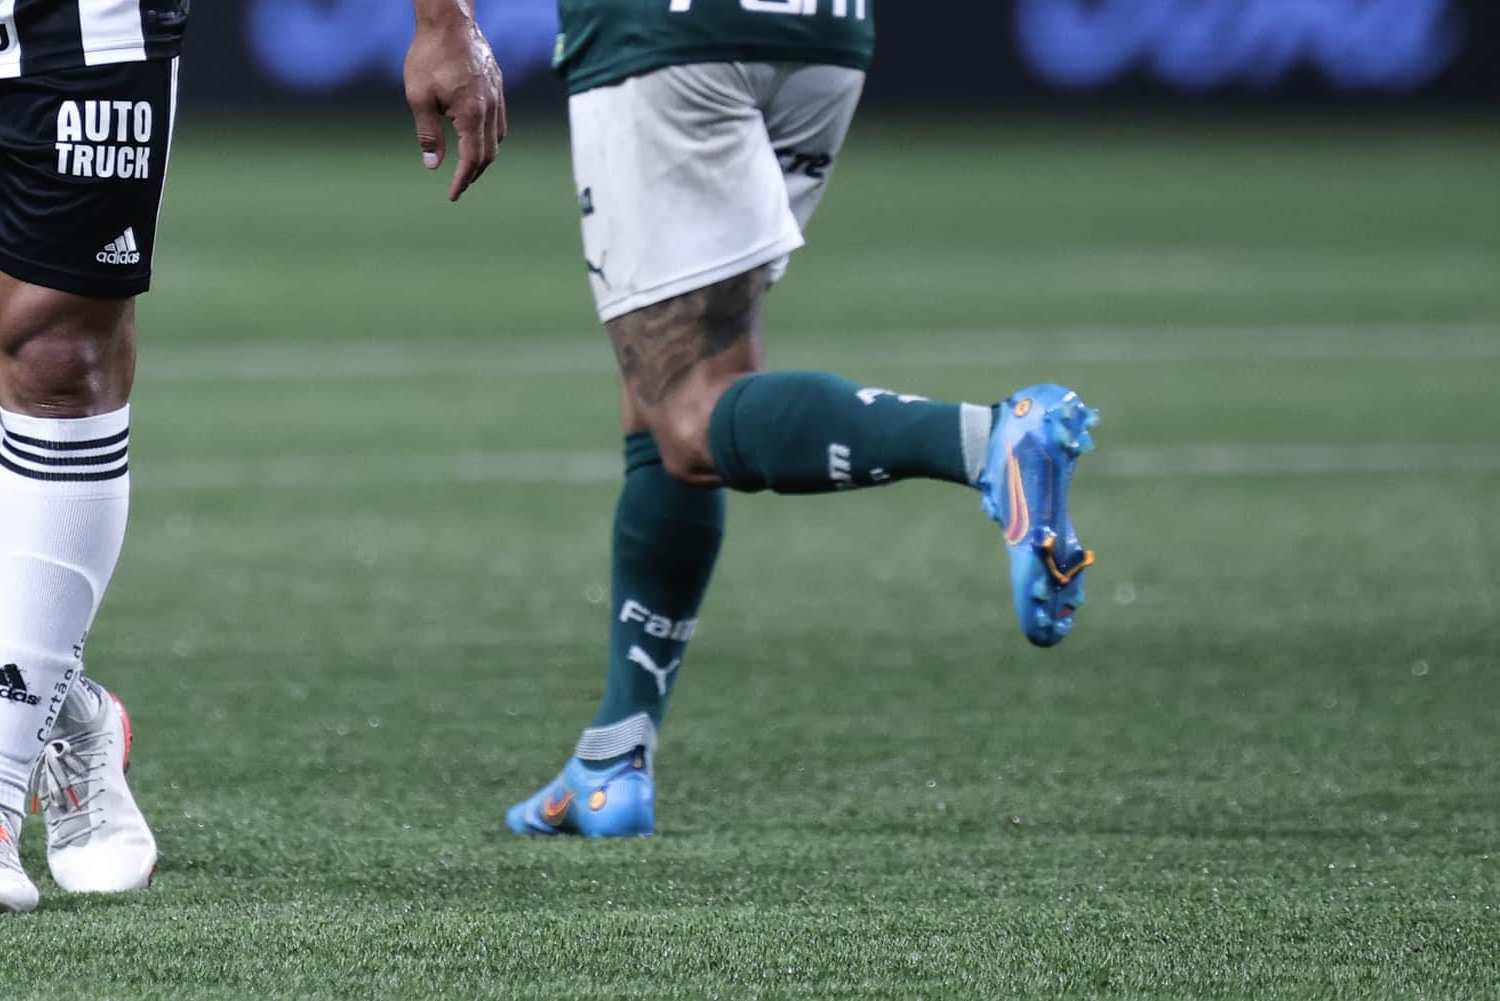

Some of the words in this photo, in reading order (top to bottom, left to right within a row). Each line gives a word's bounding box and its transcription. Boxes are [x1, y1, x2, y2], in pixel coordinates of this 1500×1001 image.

[57, 100, 152, 143] AUTO
[55, 143, 150, 179] TRUCK
[95, 251, 140, 265] adidas
